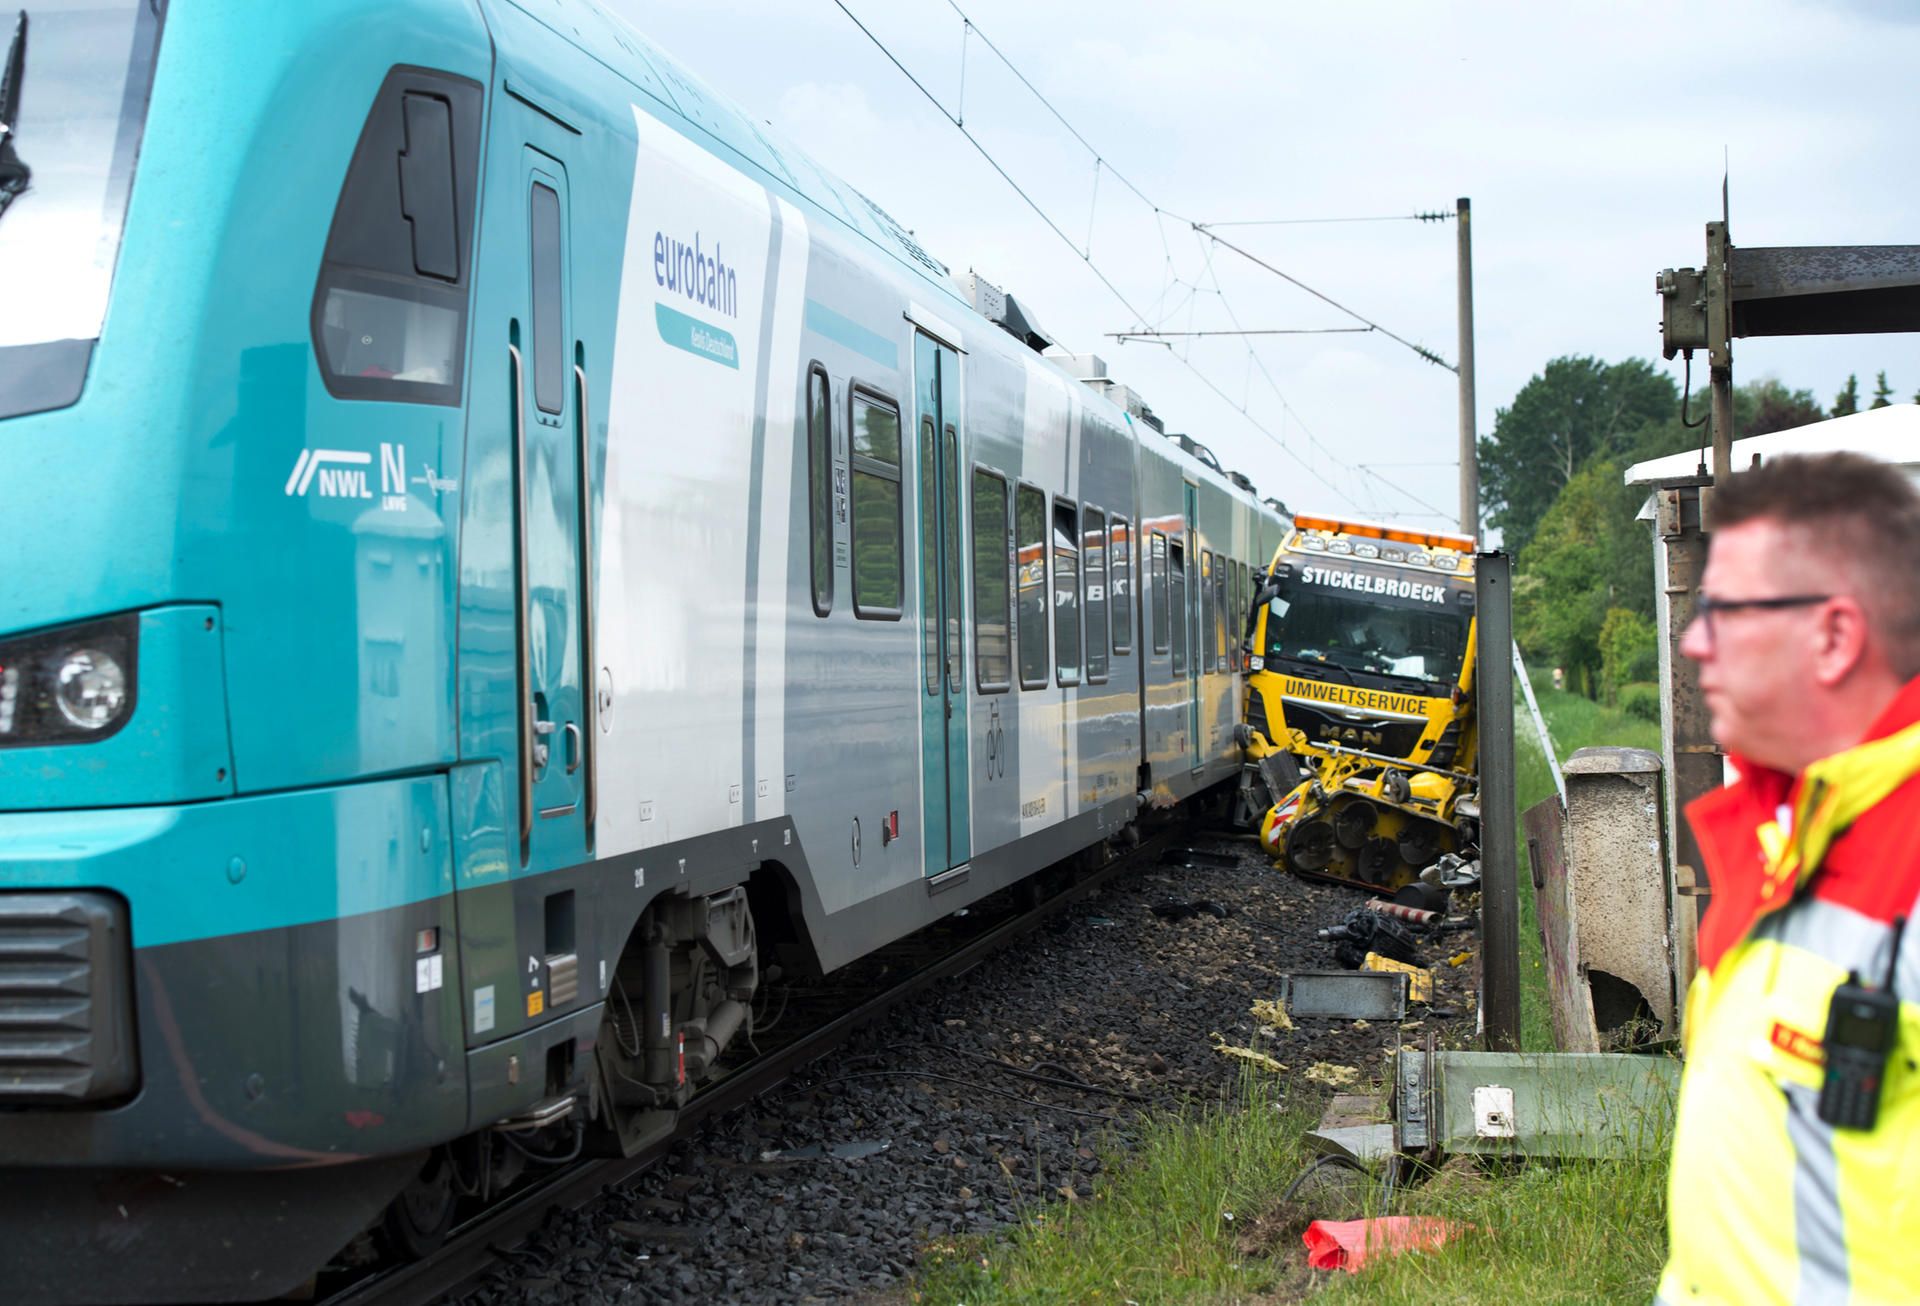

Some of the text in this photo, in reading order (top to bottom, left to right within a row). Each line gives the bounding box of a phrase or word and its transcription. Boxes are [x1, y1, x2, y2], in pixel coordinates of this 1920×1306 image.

[654, 230, 737, 319] eurobahn
[319, 468, 373, 499] NWL
[1301, 566, 1446, 604] STICKELBROECK
[1285, 678, 1428, 716] UMWELTSERVICE
[1319, 724, 1382, 745] MAN
